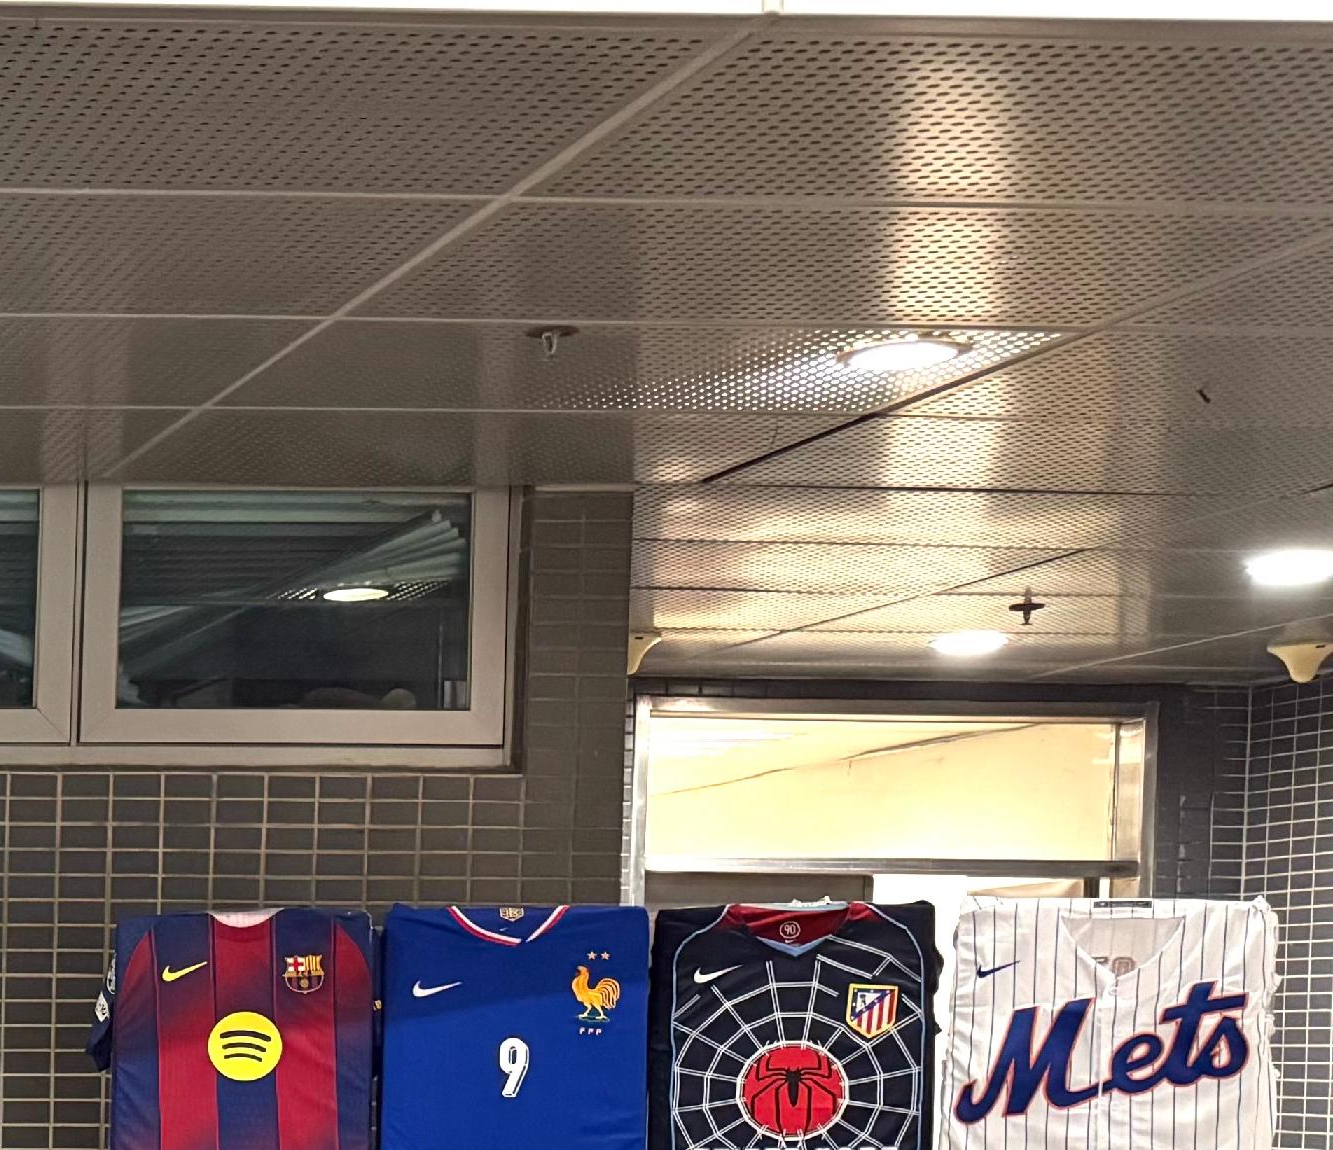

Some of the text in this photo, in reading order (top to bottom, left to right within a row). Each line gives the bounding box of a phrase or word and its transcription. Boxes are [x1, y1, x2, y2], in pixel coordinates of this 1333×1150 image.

[783, 924, 796, 936] 90
[498, 1037, 530, 1098] 9
[954, 981, 1249, 1125] Mets
